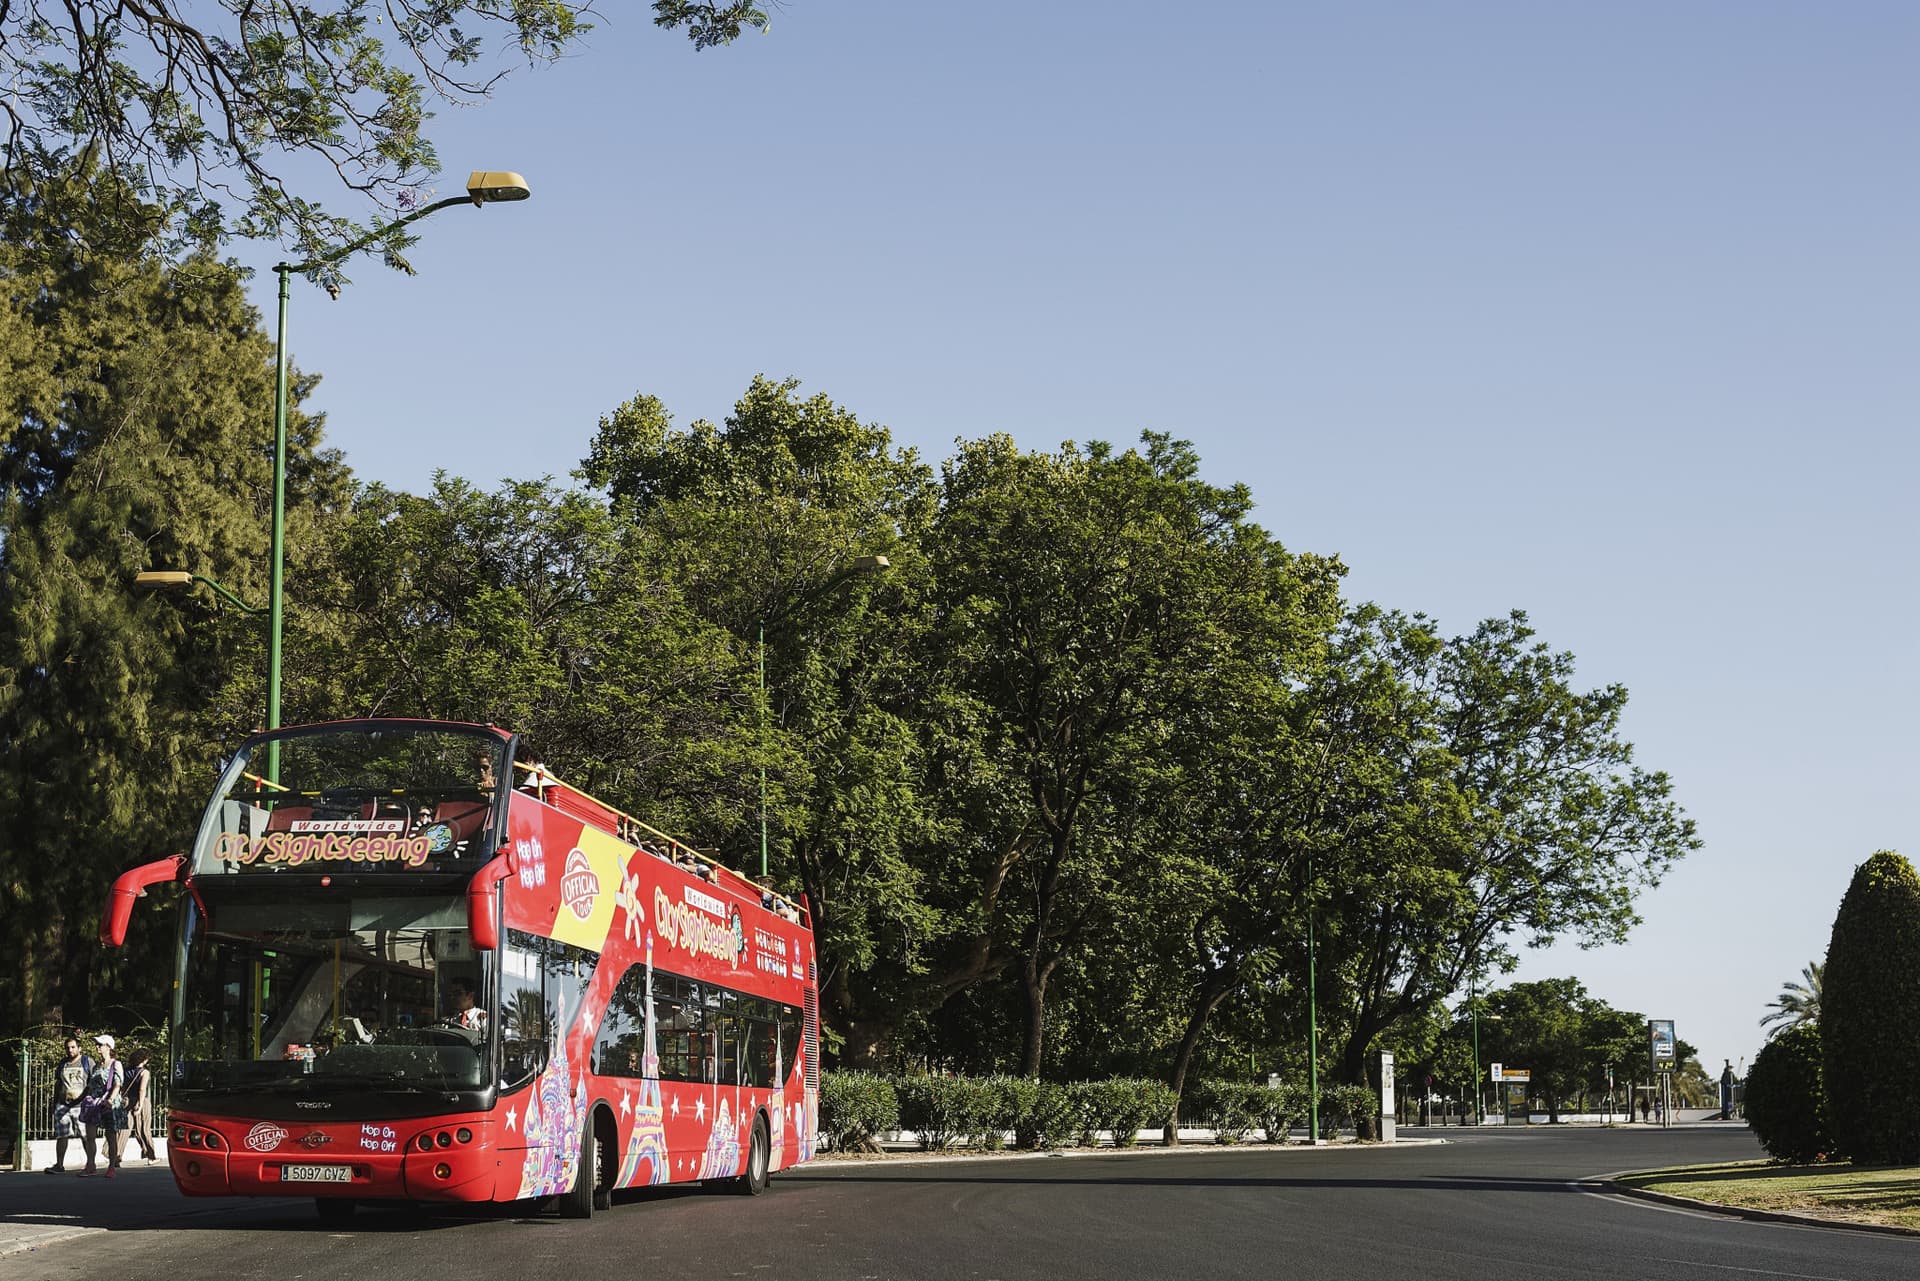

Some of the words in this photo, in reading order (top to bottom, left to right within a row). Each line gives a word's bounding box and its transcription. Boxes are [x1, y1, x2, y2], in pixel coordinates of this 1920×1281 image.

[298, 821, 397, 831] Worldwide
[516, 838, 531, 864] Hop
[531, 836, 543, 859] On
[520, 865, 535, 891] Hop
[534, 862, 546, 887] Off
[565, 875, 598, 901] OFFICIAL
[248, 1130, 286, 1146] OFFICIAL
[361, 1124, 380, 1137] Hop
[382, 1126, 395, 1138] On
[360, 1138, 378, 1150] Hop
[380, 1140, 396, 1152] Off
[292, 1167, 321, 1180] 5097
